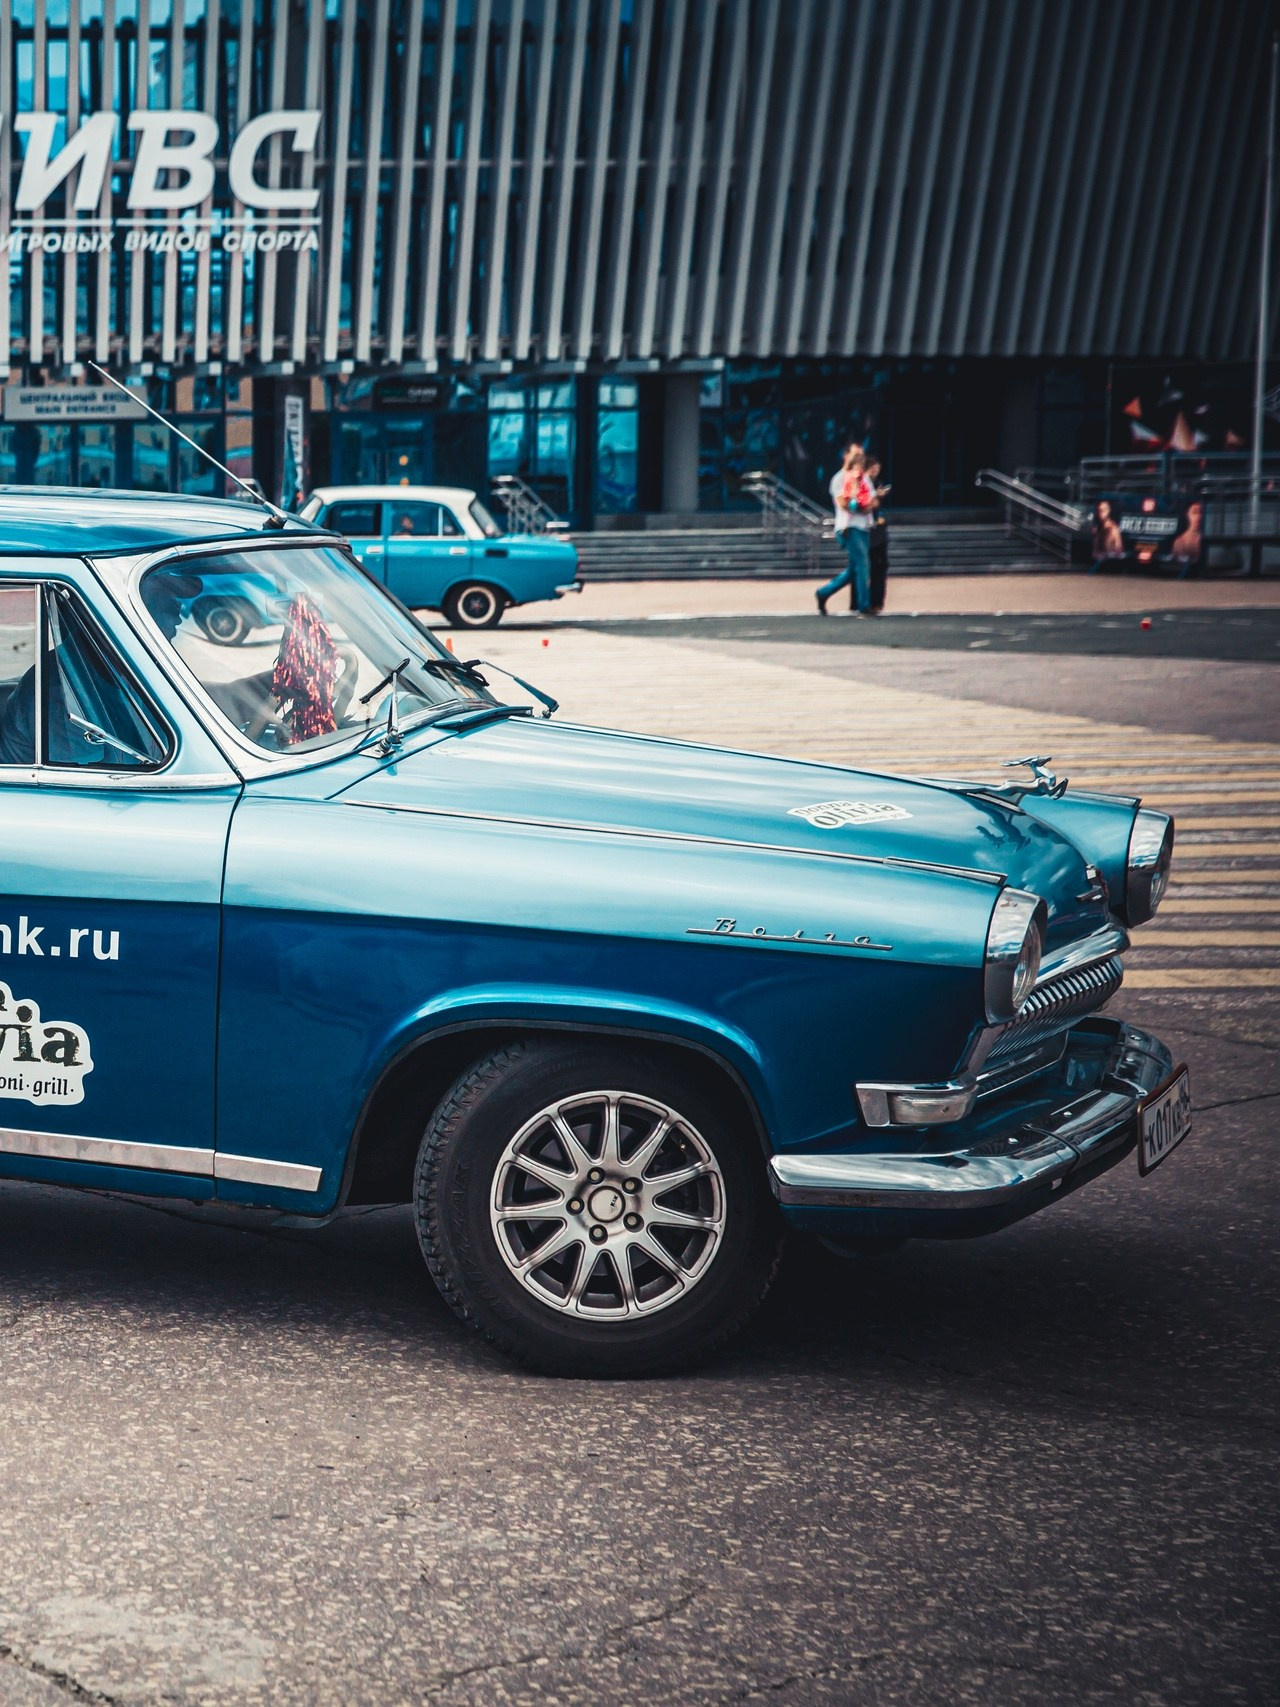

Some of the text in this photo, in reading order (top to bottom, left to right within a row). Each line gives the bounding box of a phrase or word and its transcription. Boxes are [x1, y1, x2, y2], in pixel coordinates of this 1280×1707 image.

[124, 230, 210, 253] ВИДОВ
[222, 230, 319, 253] СПОРТА
[814, 802, 896, 827] Olivia
